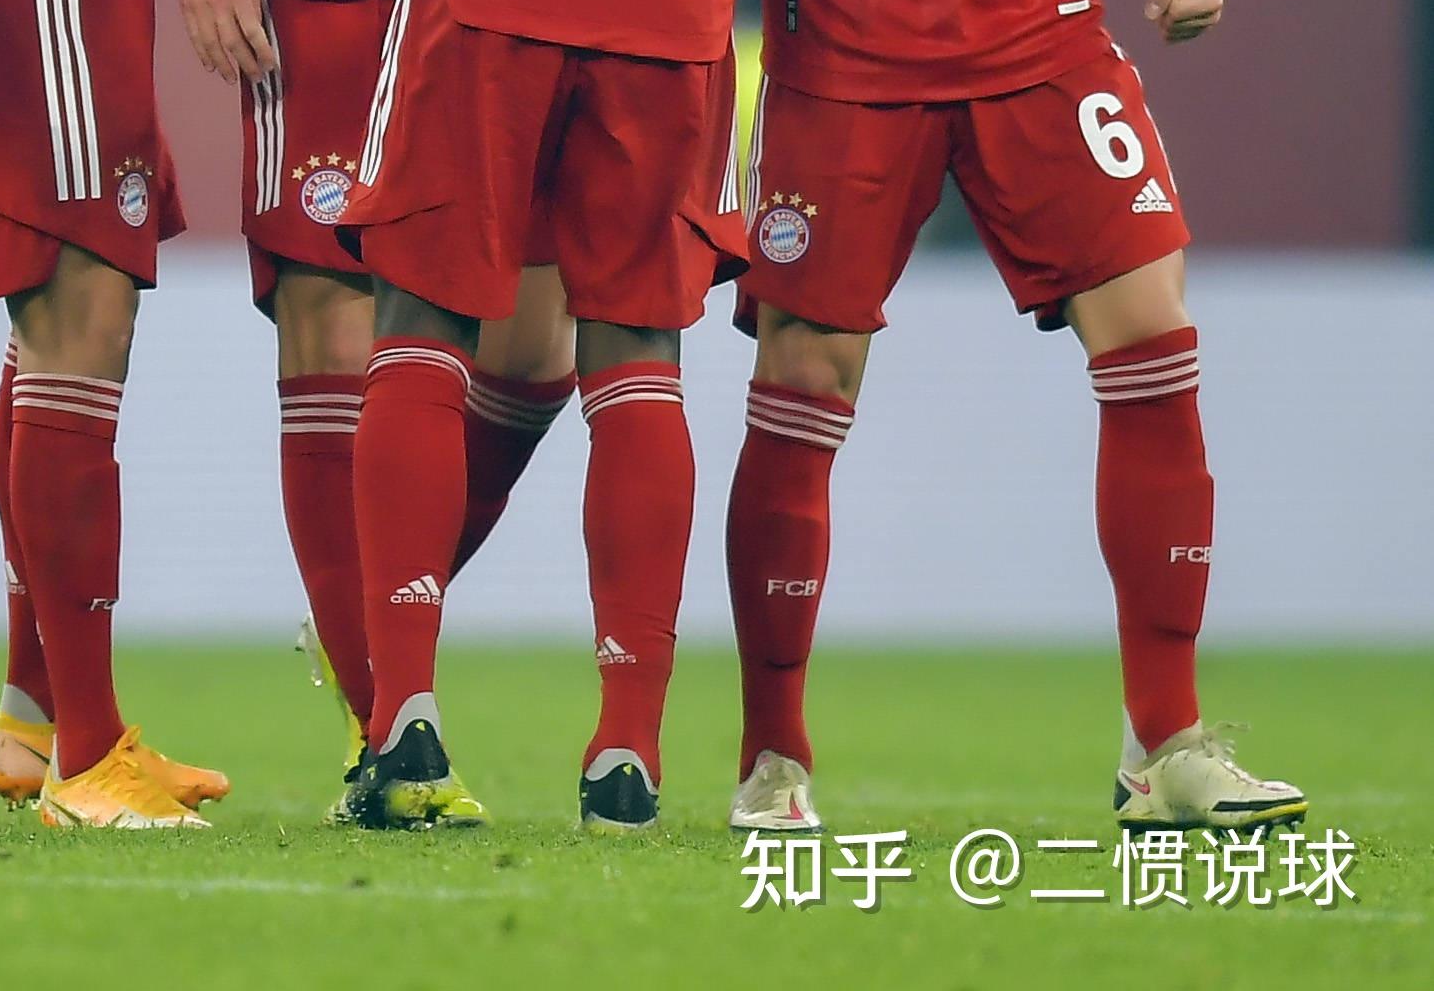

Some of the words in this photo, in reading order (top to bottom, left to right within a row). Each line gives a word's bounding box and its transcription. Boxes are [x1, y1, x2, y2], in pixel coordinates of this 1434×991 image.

[1078, 92, 1144, 179] 6
[1170, 546, 1213, 564] FCB
[766, 579, 819, 597] FCB
[389, 591, 443, 607] adida
